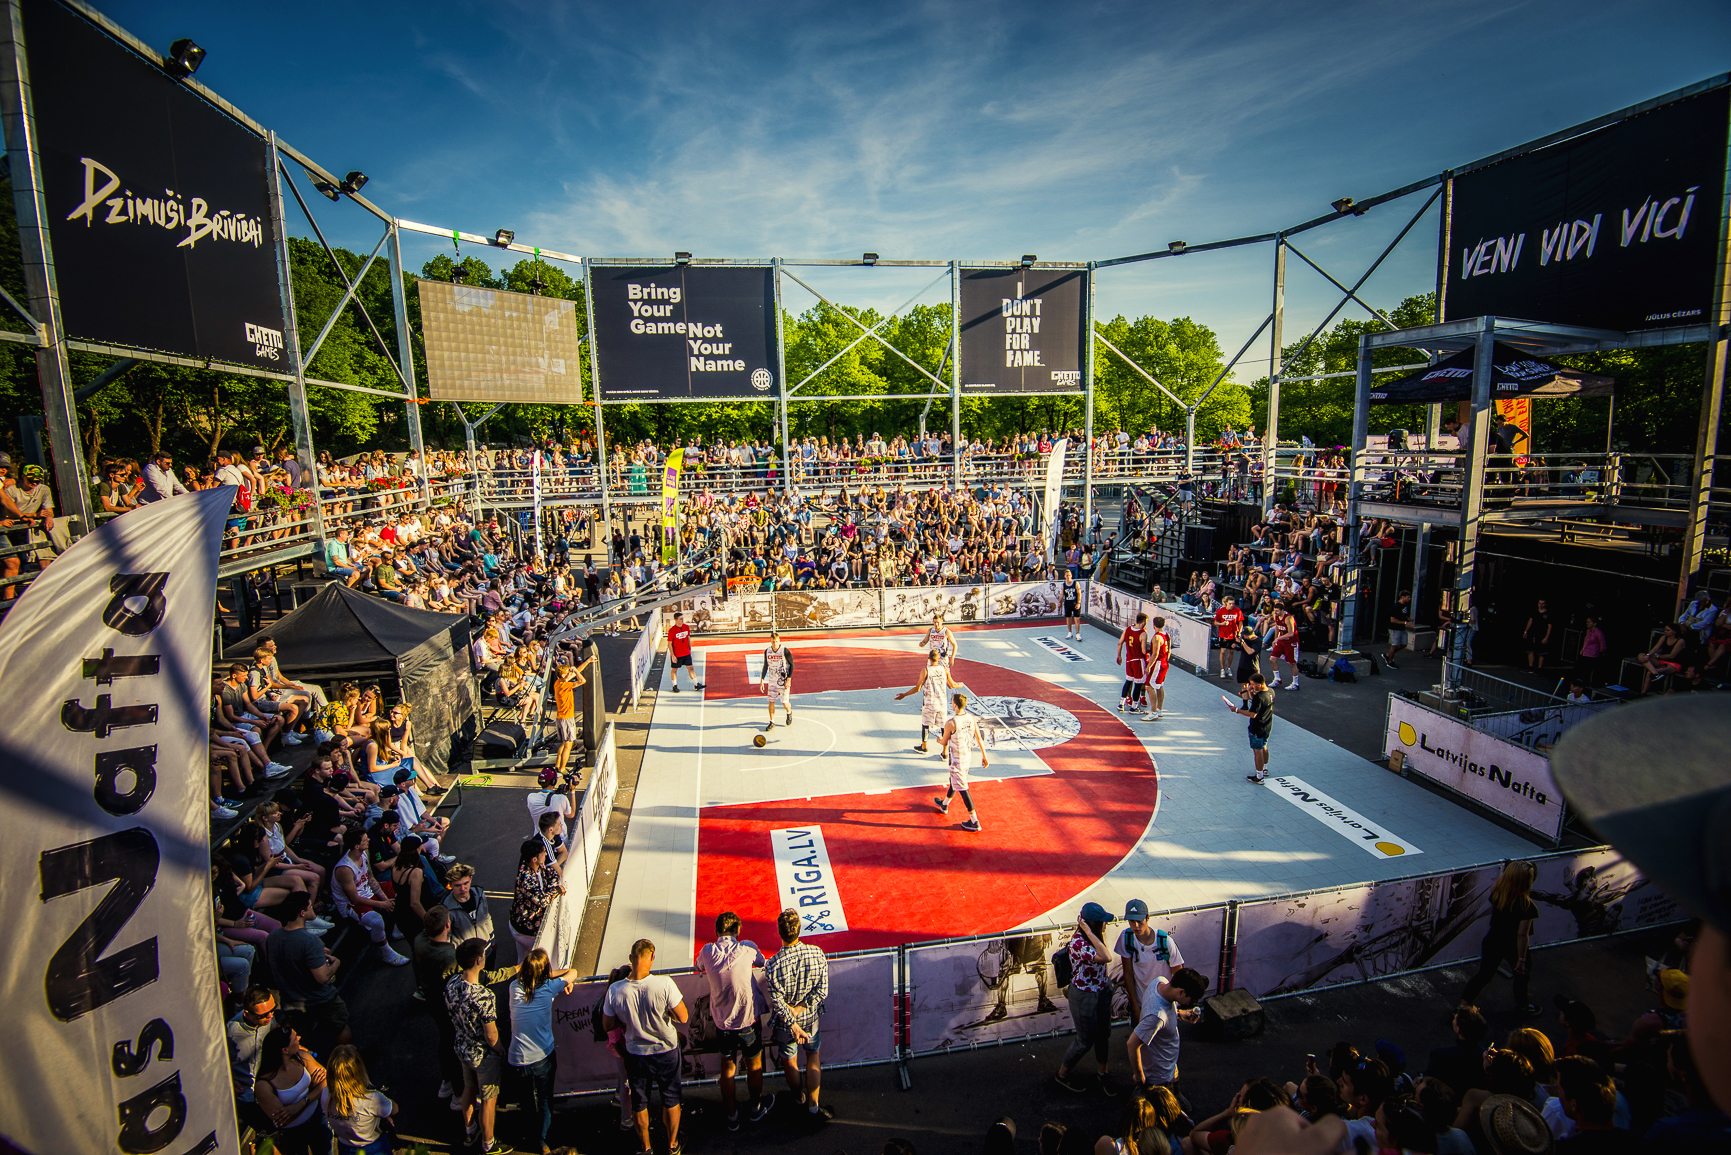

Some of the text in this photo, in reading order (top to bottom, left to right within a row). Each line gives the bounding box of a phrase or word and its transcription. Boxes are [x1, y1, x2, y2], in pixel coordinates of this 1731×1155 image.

[1461, 232, 1526, 280] VENI
[1540, 213, 1603, 267] VIDI
[627, 283, 682, 303] Bring
[1016, 281, 1023, 300] I
[627, 301, 674, 317] Your
[1001, 298, 1043, 318] DON'T
[630, 318, 687, 335] Game
[687, 322, 724, 338] Not
[1005, 316, 1041, 334] PLAY
[244, 322, 284, 350] GHETTO
[1005, 333, 1030, 350] FOR
[255, 343, 280, 361] GAMES
[687, 339, 733, 355] Your
[690, 356, 746, 372] Name
[1051, 370, 1081, 381] GHETTO
[1421, 367, 1474, 381] GHETTO
[1036, 637, 1087, 662] MAXIMA
[1128, 635, 1134, 647] 2
[1420, 733, 1547, 806] Latvijas Nafta
[38, 571, 171, 1024] Nafta
[1275, 777, 1381, 841] Latvijas Nafta
[375, 852, 382, 861] 3
[786, 829, 829, 908] RĪGA.LV
[554, 1005, 590, 1025] DREAM
[569, 1018, 593, 1033] WHI
